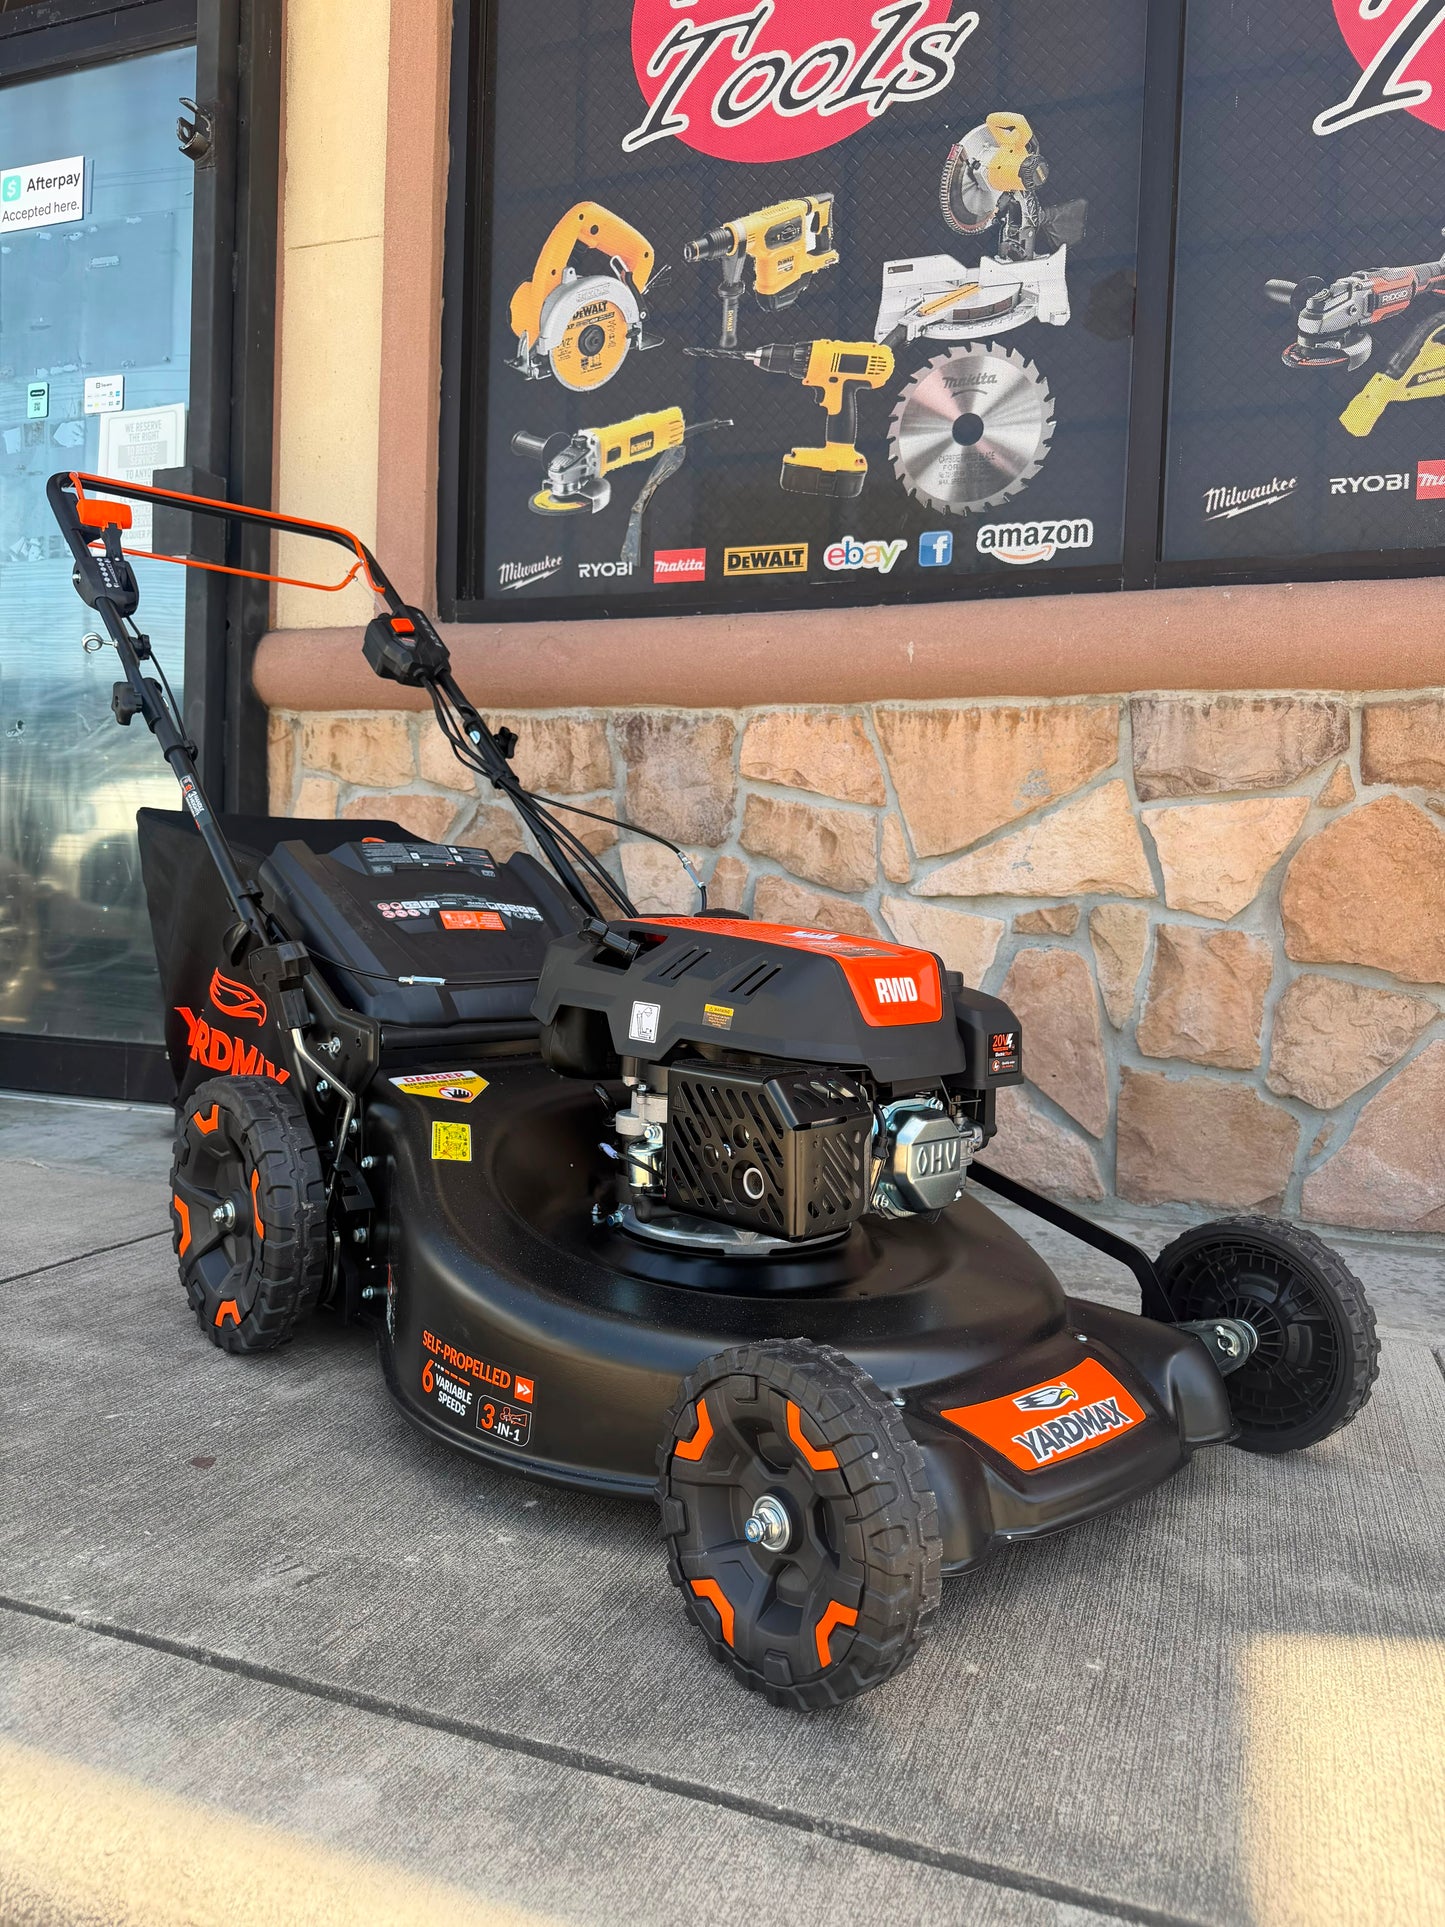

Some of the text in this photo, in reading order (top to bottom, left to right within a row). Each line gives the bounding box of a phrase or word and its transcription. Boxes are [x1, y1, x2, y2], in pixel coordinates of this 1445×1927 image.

[625, 1, 977, 149] Tools
[27, 172, 81, 192] Afterpay
[2, 200, 80, 222] Accepted here.
[1383, 290, 1408, 302] RIDGID
[125, 419, 162, 433] WE RESERVE
[128, 431, 160, 443] THE RIGHT
[1202, 476, 1298, 513] Milwaukee
[1330, 473, 1410, 494] RYOBI
[497, 555, 564, 584] Milwaukee
[578, 562, 632, 578] RYOBI
[827, 540, 901, 572] ebay
[981, 522, 1089, 549] amazon
[874, 977, 918, 1003] RWD
[403, 1072, 467, 1083] DANGER
[916, 1141, 957, 1174] OHV
[422, 1330, 511, 1389] SELF-PROPELLED
[422, 1359, 473, 1405] 6 VARIABLE
[438, 1391, 466, 1416] SPEEDS
[1013, 1397, 1132, 1461] YARDMAX
